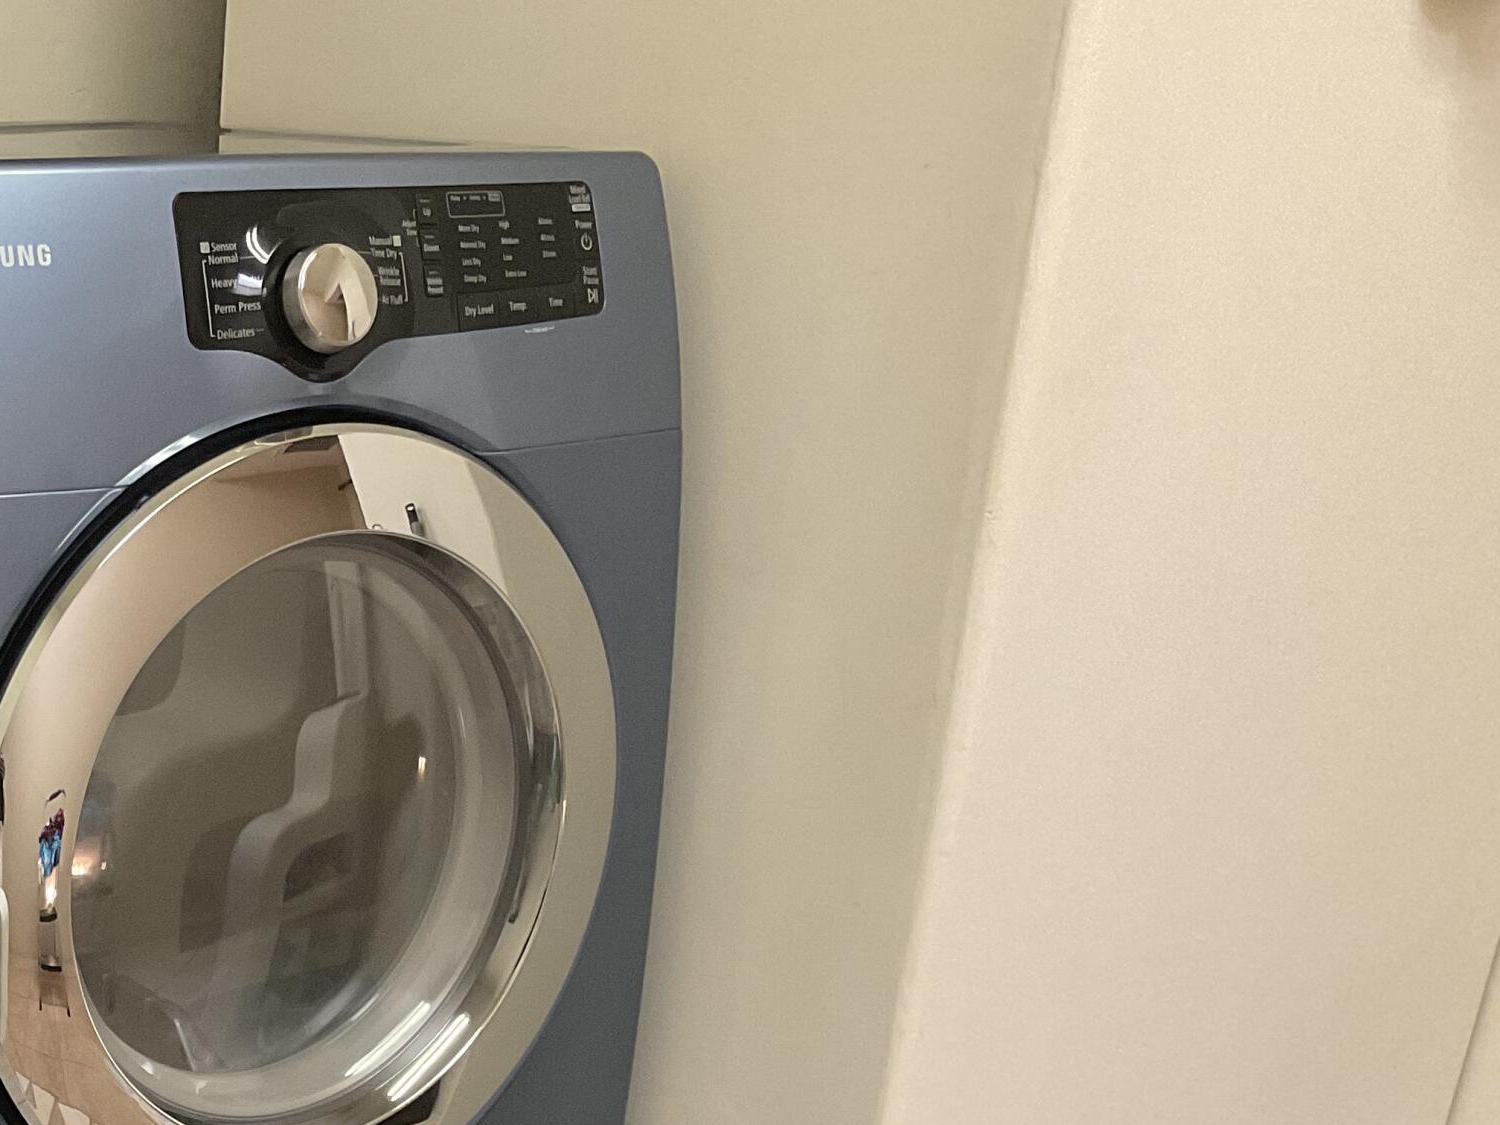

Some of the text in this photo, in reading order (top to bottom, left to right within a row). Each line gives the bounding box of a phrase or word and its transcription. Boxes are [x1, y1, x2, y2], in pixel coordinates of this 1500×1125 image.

[210, 242, 237, 252] Sensor
[208, 252, 239, 265] Normal
[211, 278, 238, 288] Heavy
[214, 301, 262, 315] Perm Press
[216, 328, 256, 340] Delicates
